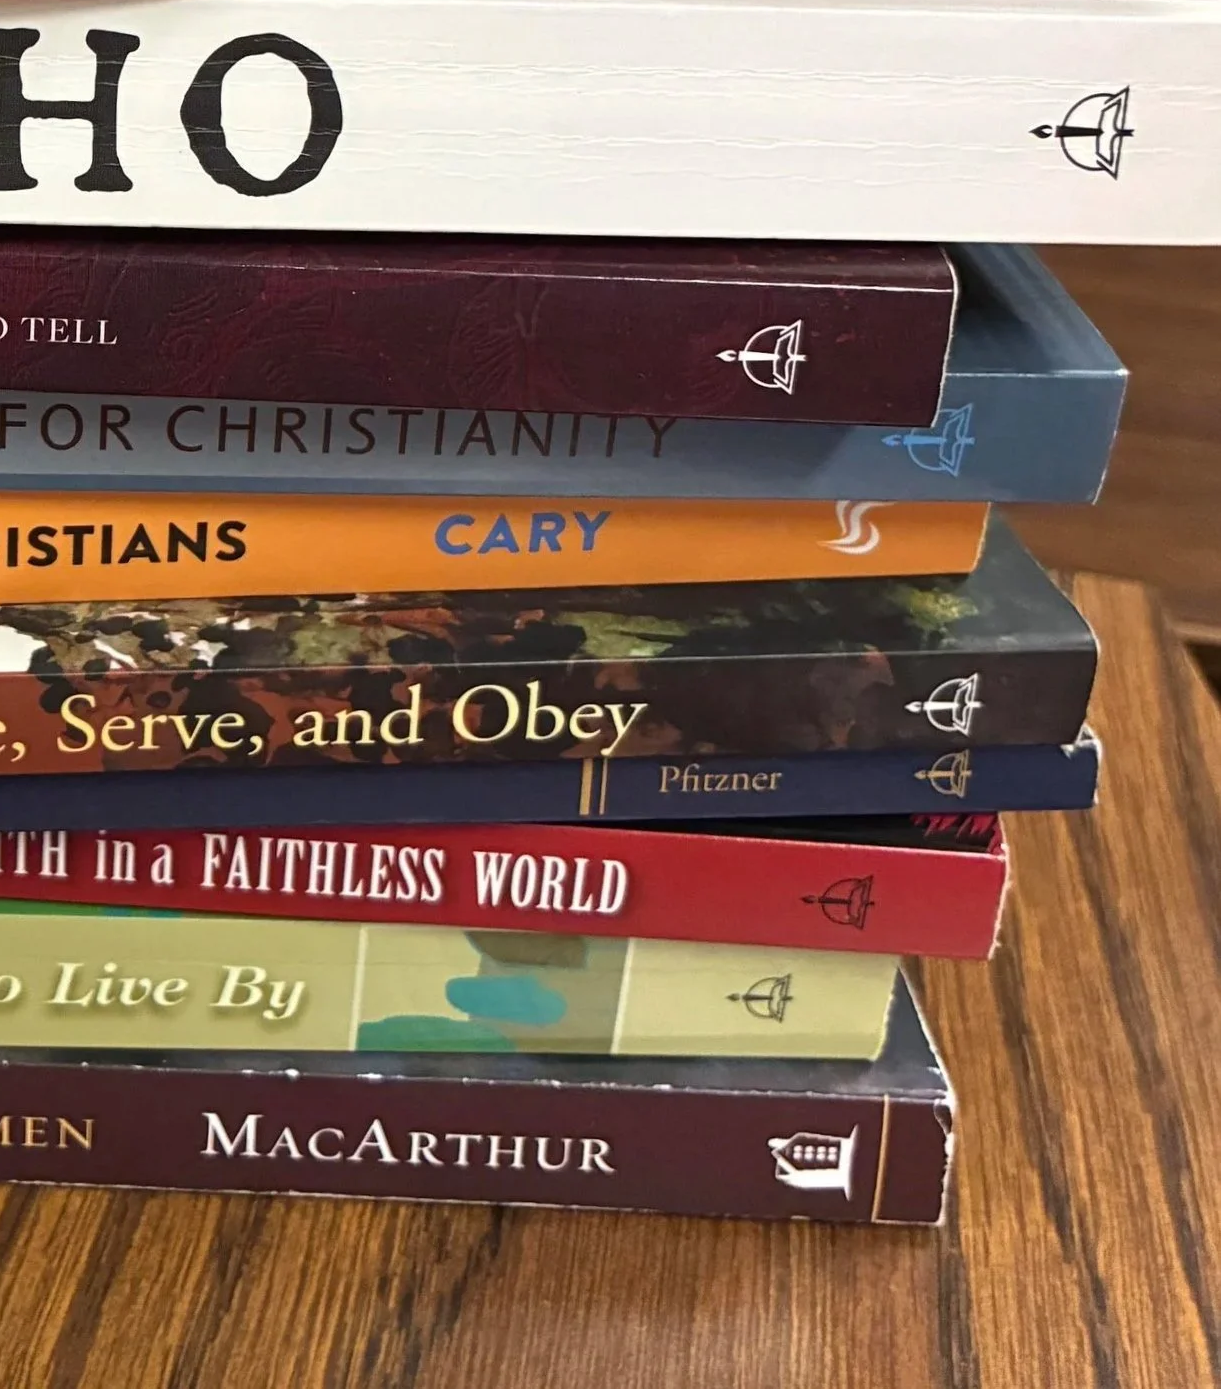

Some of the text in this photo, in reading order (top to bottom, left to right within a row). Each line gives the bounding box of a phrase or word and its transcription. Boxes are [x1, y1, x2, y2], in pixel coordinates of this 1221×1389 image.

[20, 317, 118, 347] TELL
[165, 404, 678, 459] CHRISTIANITY
[433, 509, 612, 556] CARY
[55, 689, 266, 757] Serve,
[292, 687, 423, 751] and
[452, 679, 650, 757] Obey
[657, 761, 784, 795] Pfitzner
[93, 827, 138, 885] in
[149, 841, 175, 887] a
[199, 831, 446, 903] FAITHLESS
[472, 849, 630, 915] WORLD
[46, 959, 189, 1007] Live
[210, 963, 306, 1019] By
